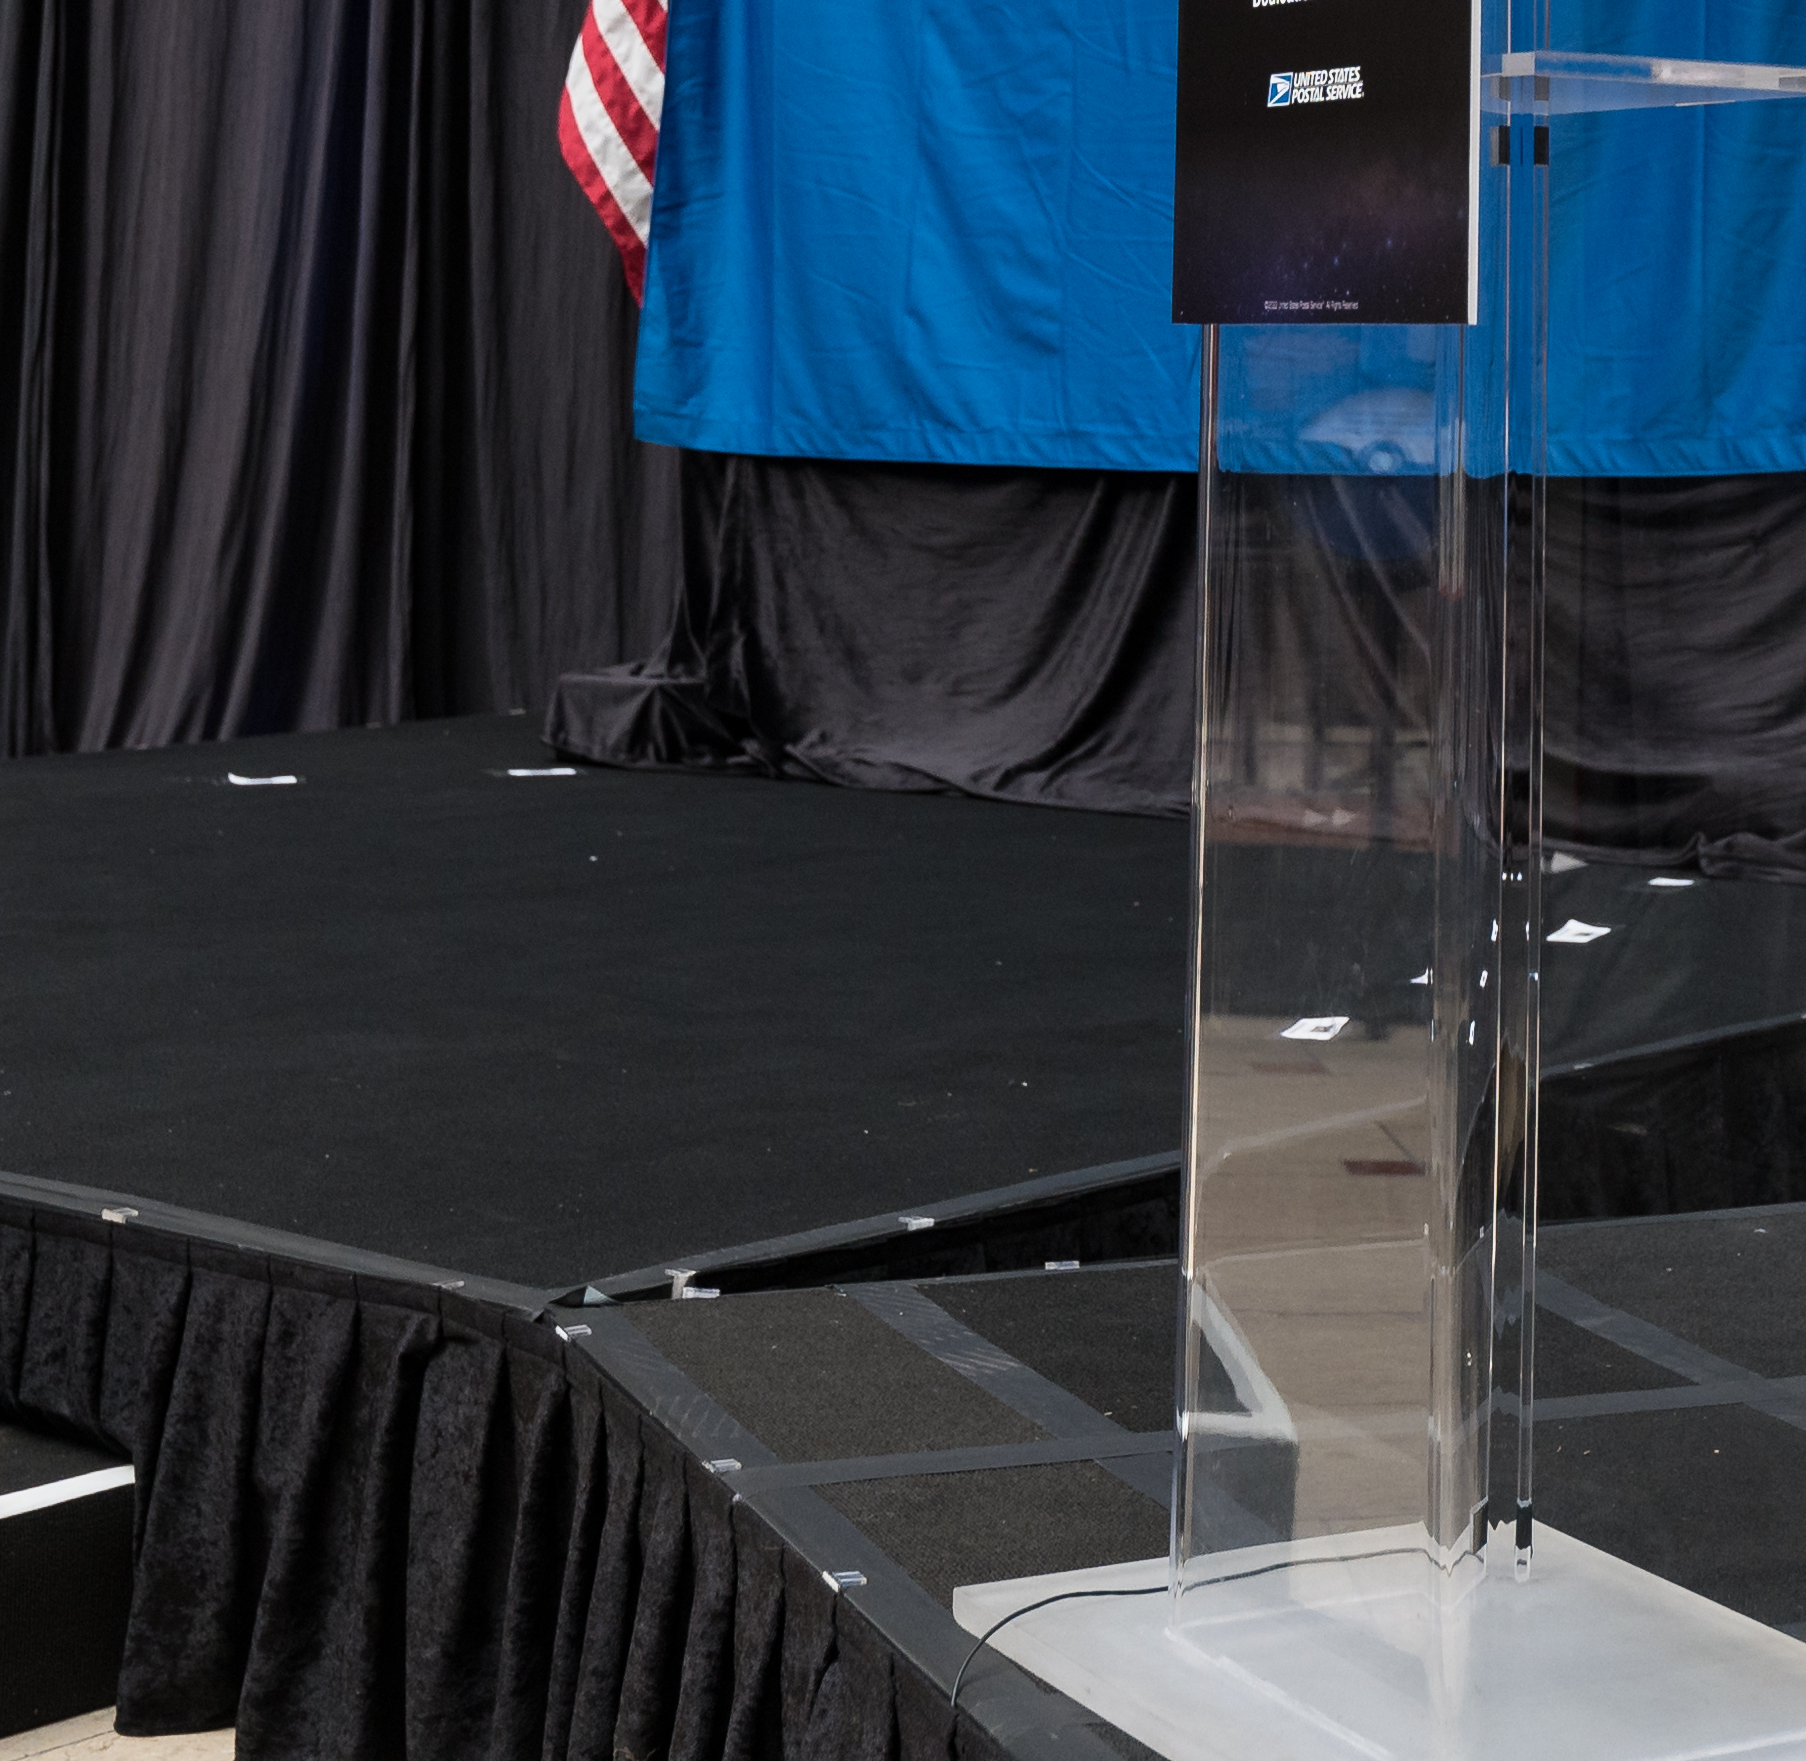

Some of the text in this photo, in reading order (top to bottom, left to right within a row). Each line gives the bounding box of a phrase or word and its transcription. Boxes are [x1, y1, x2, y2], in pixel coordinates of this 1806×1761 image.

[1294, 65, 1361, 88] UNITED STATES
[1292, 87, 1325, 105] POSTAL
